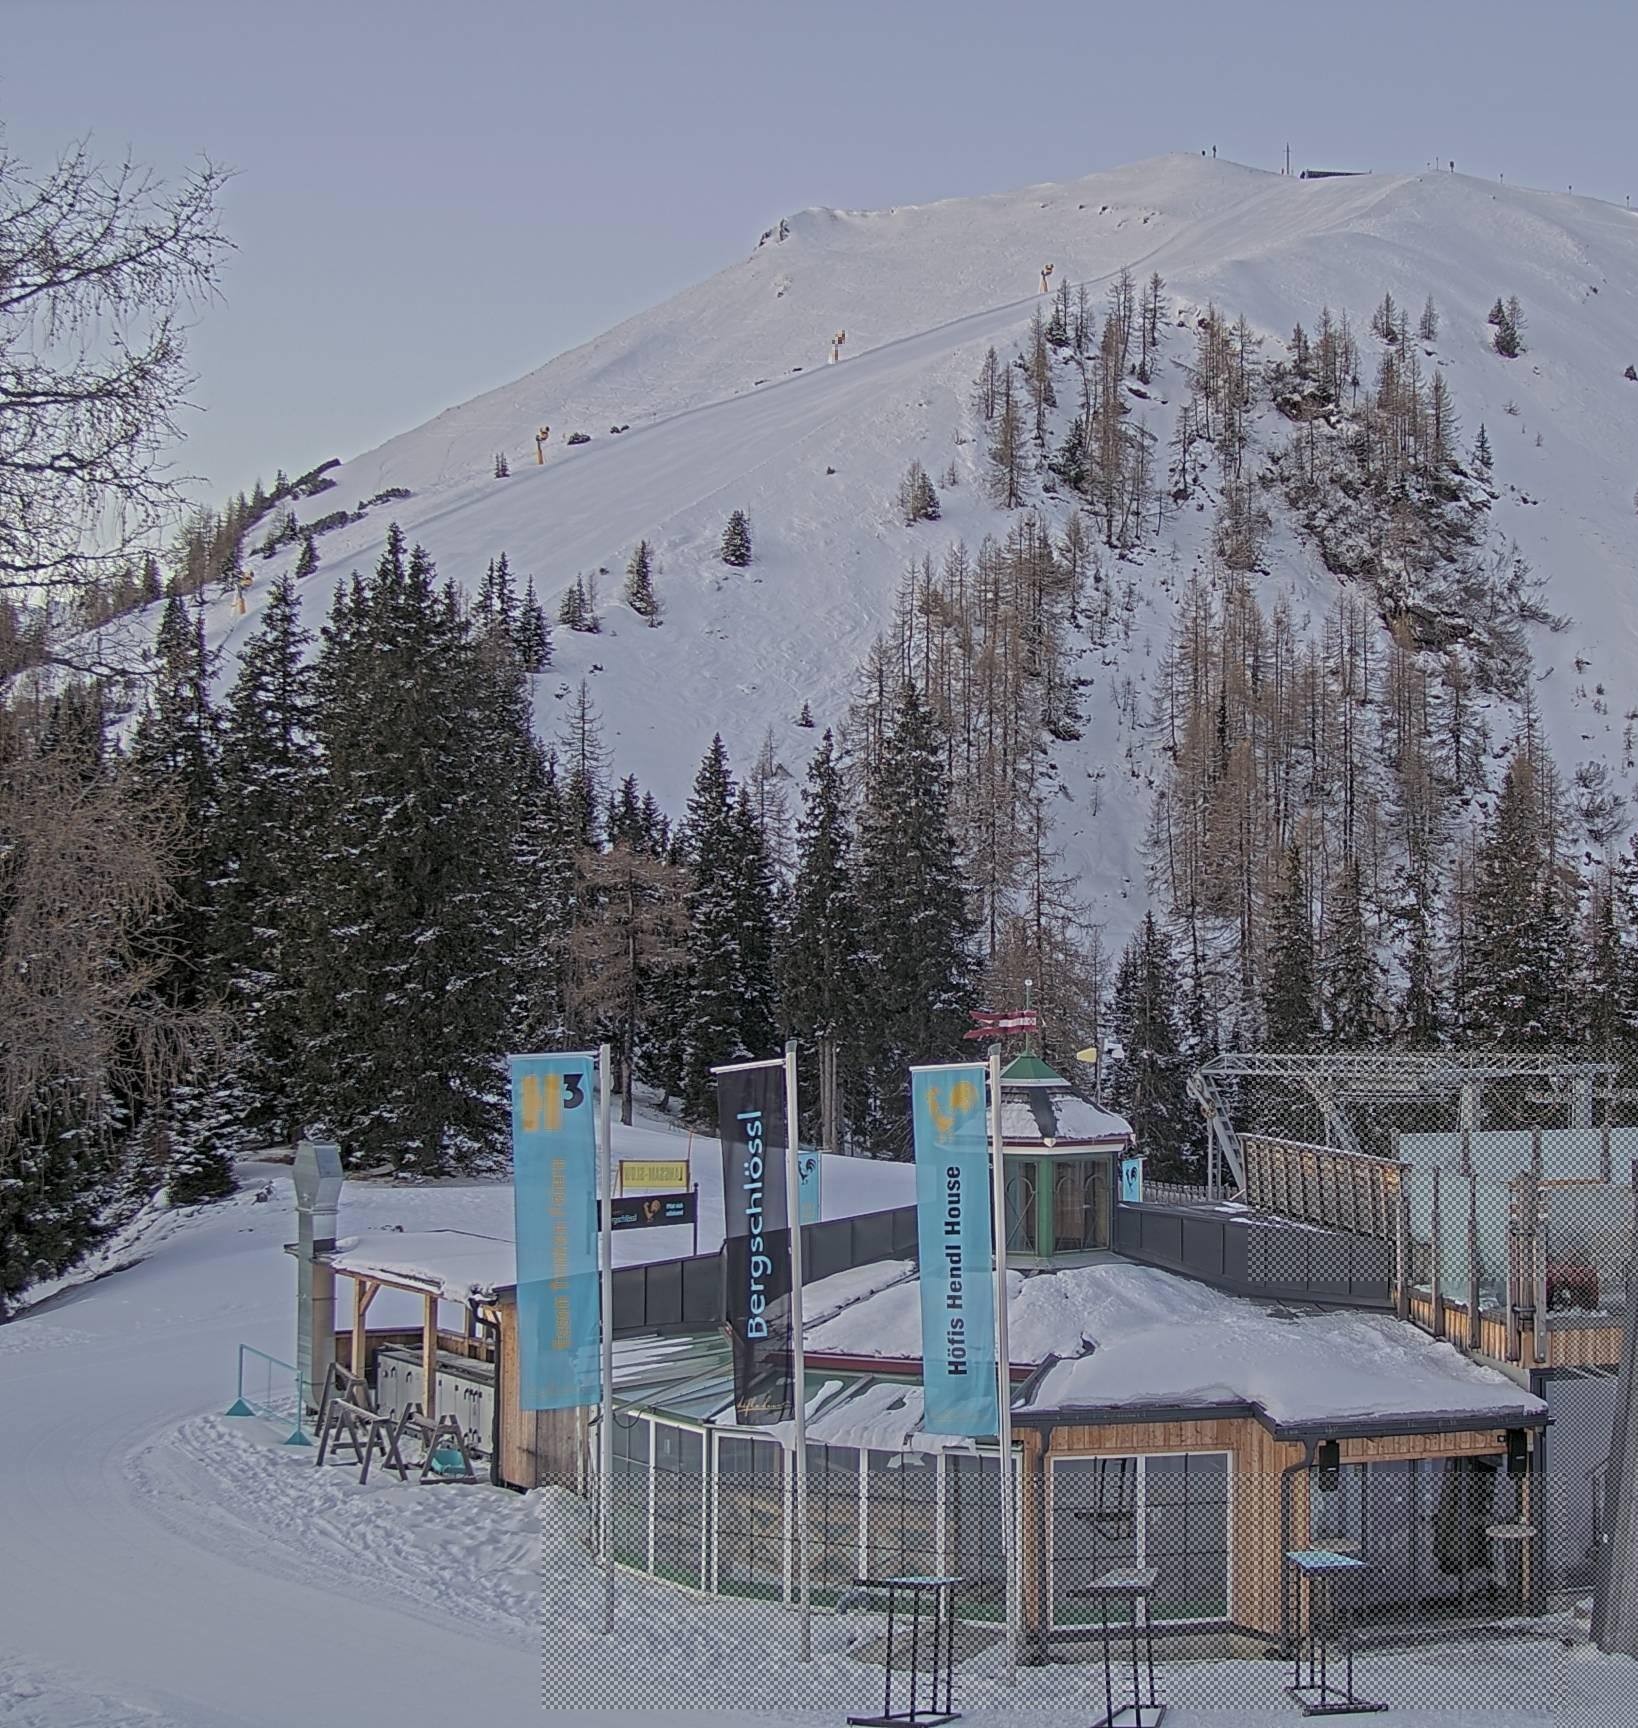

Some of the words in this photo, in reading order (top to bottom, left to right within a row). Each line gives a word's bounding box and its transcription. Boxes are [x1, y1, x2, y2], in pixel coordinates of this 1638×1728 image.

[737, 1111, 772, 1338] Bergschlössl
[944, 1166, 961, 1235] House
[945, 1245, 962, 1309] Hendl
[947, 1318, 967, 1376] Höfis
